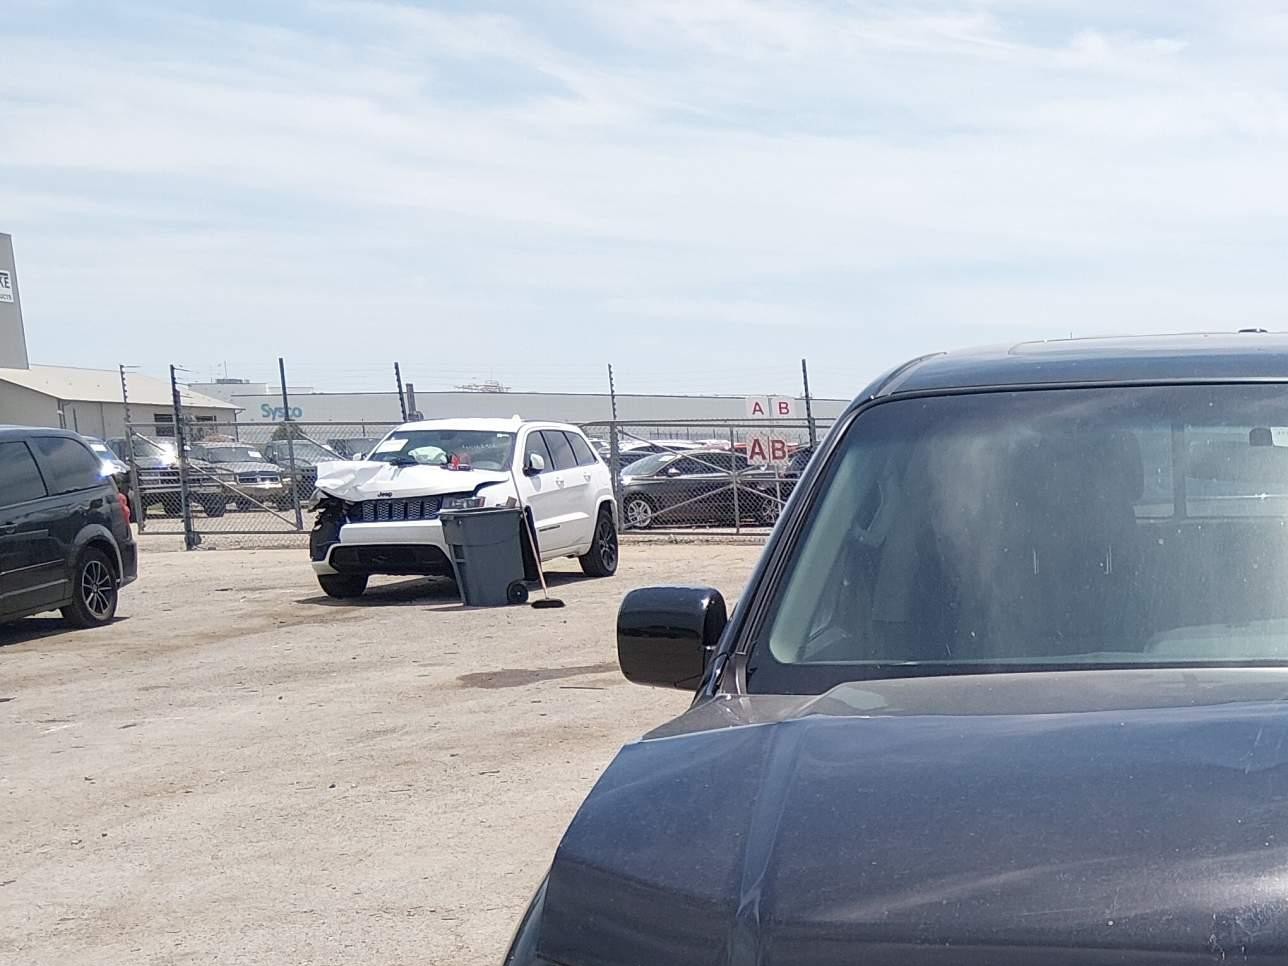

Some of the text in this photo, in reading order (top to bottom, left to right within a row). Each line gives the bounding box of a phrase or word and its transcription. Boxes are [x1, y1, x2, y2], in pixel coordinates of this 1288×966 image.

[752, 401, 764, 415] A
[779, 401, 790, 415] B
[749, 438, 767, 460] A
[770, 439, 787, 460] B
